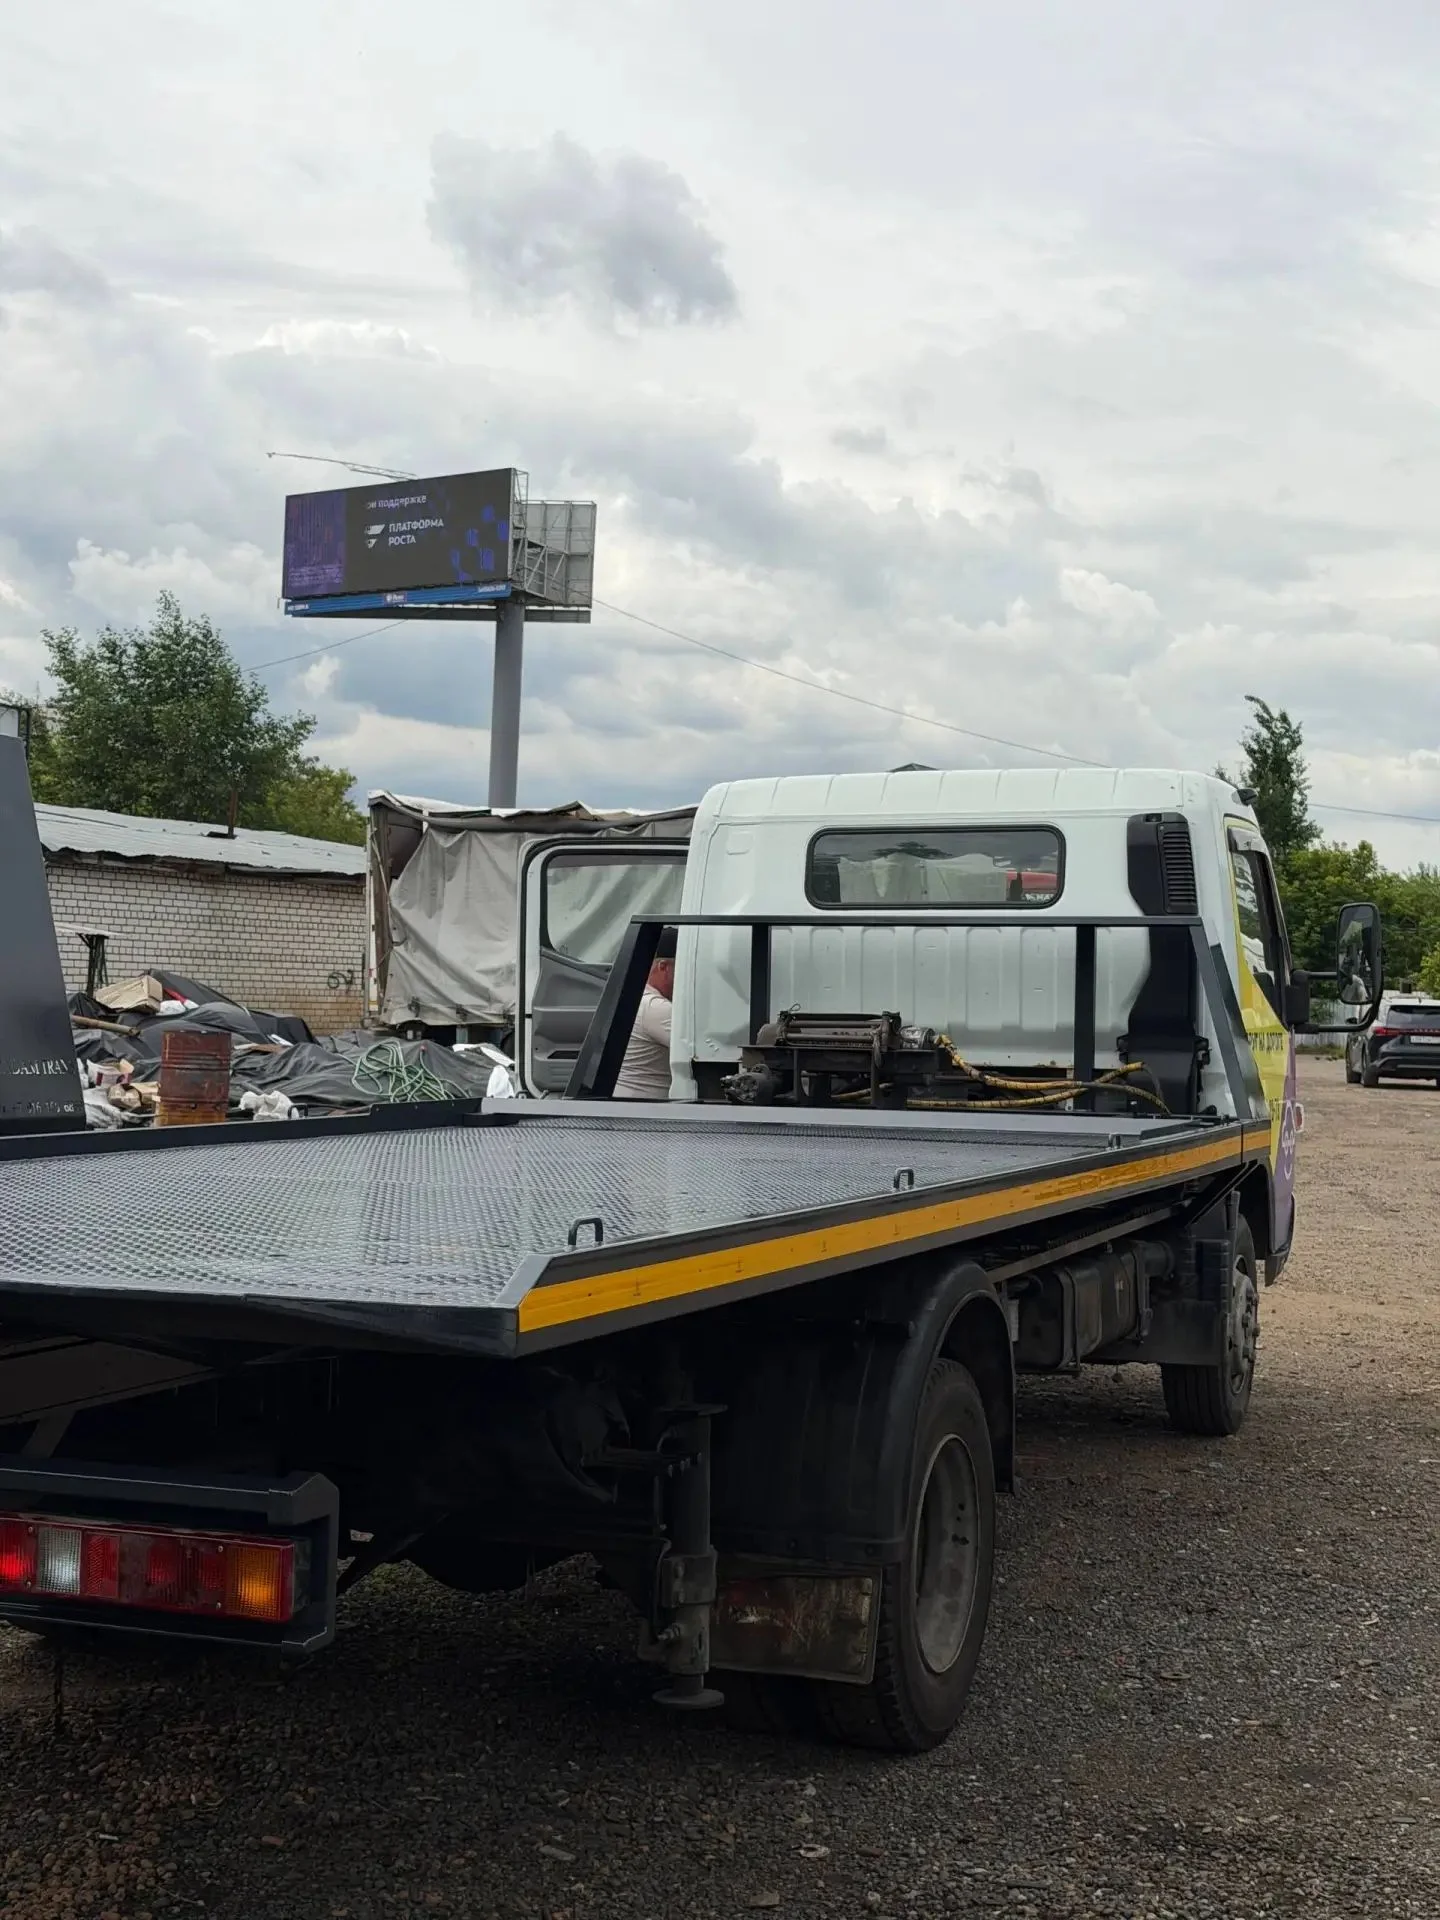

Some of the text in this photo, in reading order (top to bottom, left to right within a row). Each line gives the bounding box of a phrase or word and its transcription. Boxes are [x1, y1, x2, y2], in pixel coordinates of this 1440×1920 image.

[378, 495, 427, 509] поддержке
[389, 518, 445, 533] ПЛАТФОРМА
[388, 534, 417, 547] РОСТА
